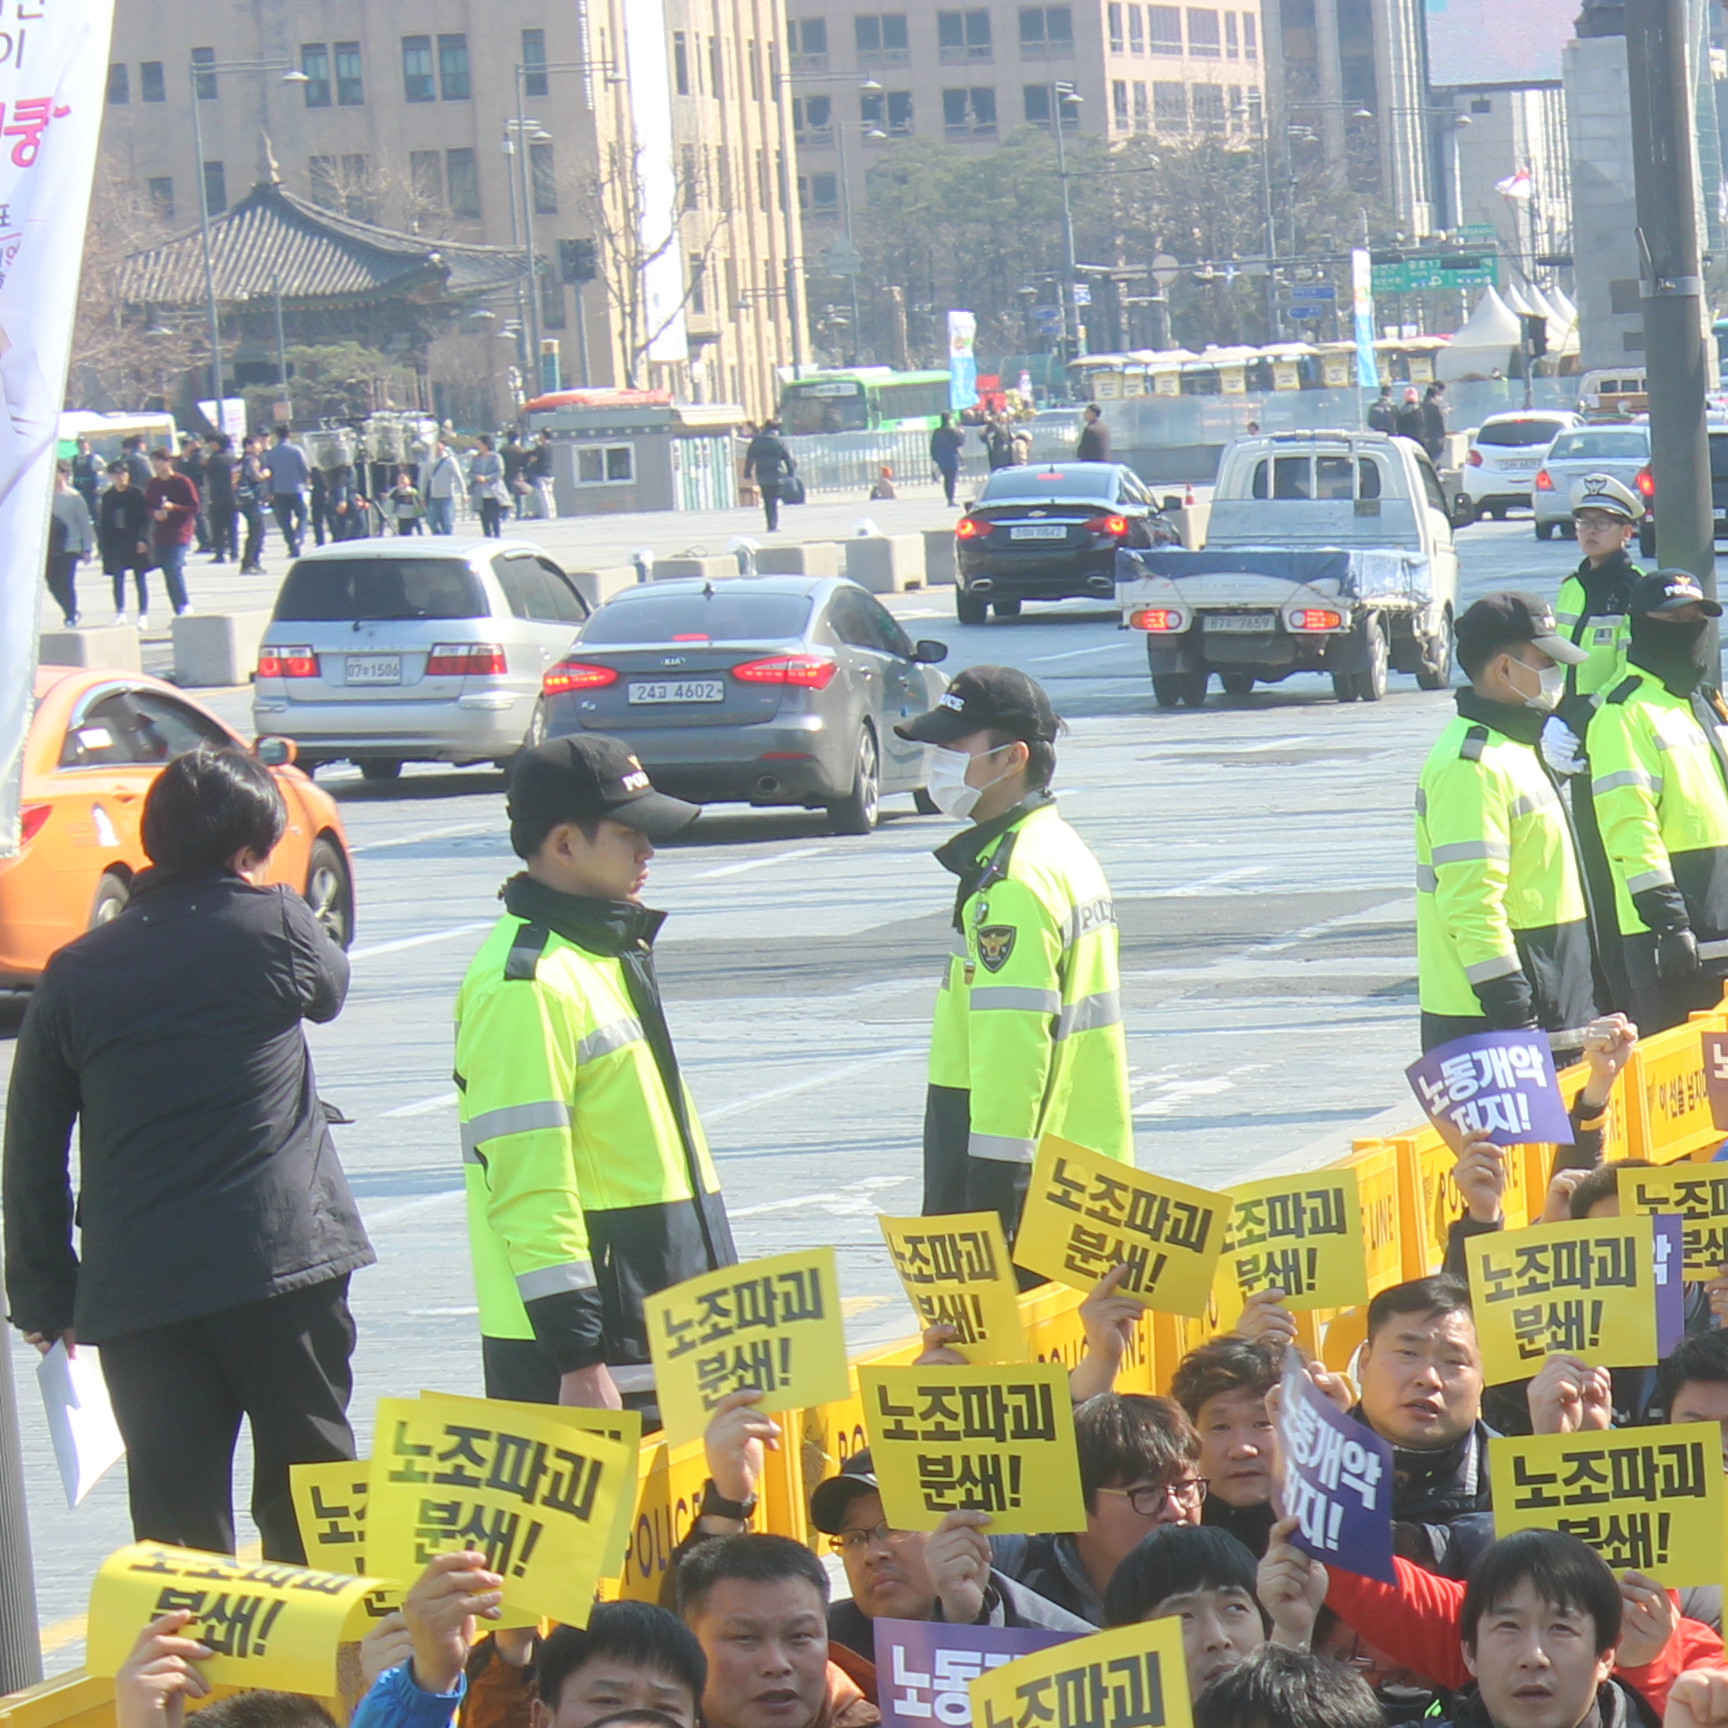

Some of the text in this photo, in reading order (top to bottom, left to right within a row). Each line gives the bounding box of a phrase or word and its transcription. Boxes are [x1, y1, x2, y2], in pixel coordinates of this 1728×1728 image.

[673, 683, 715, 699] 4602
[1046, 1154, 1217, 1256] 노조파괴
[1481, 1233, 1639, 1303] 노조파괴
[661, 1267, 826, 1360] 노조파괴
[1514, 1299, 1604, 1360] 분쇄!
[876, 1382, 1058, 1444] 노조파괴
[388, 1418, 607, 1524] 노조파괴
[917, 1453, 1023, 1514] 분쇄!
[1513, 1439, 1705, 1512] 노조파괴
[412, 1498, 546, 1581] 분쇄!
